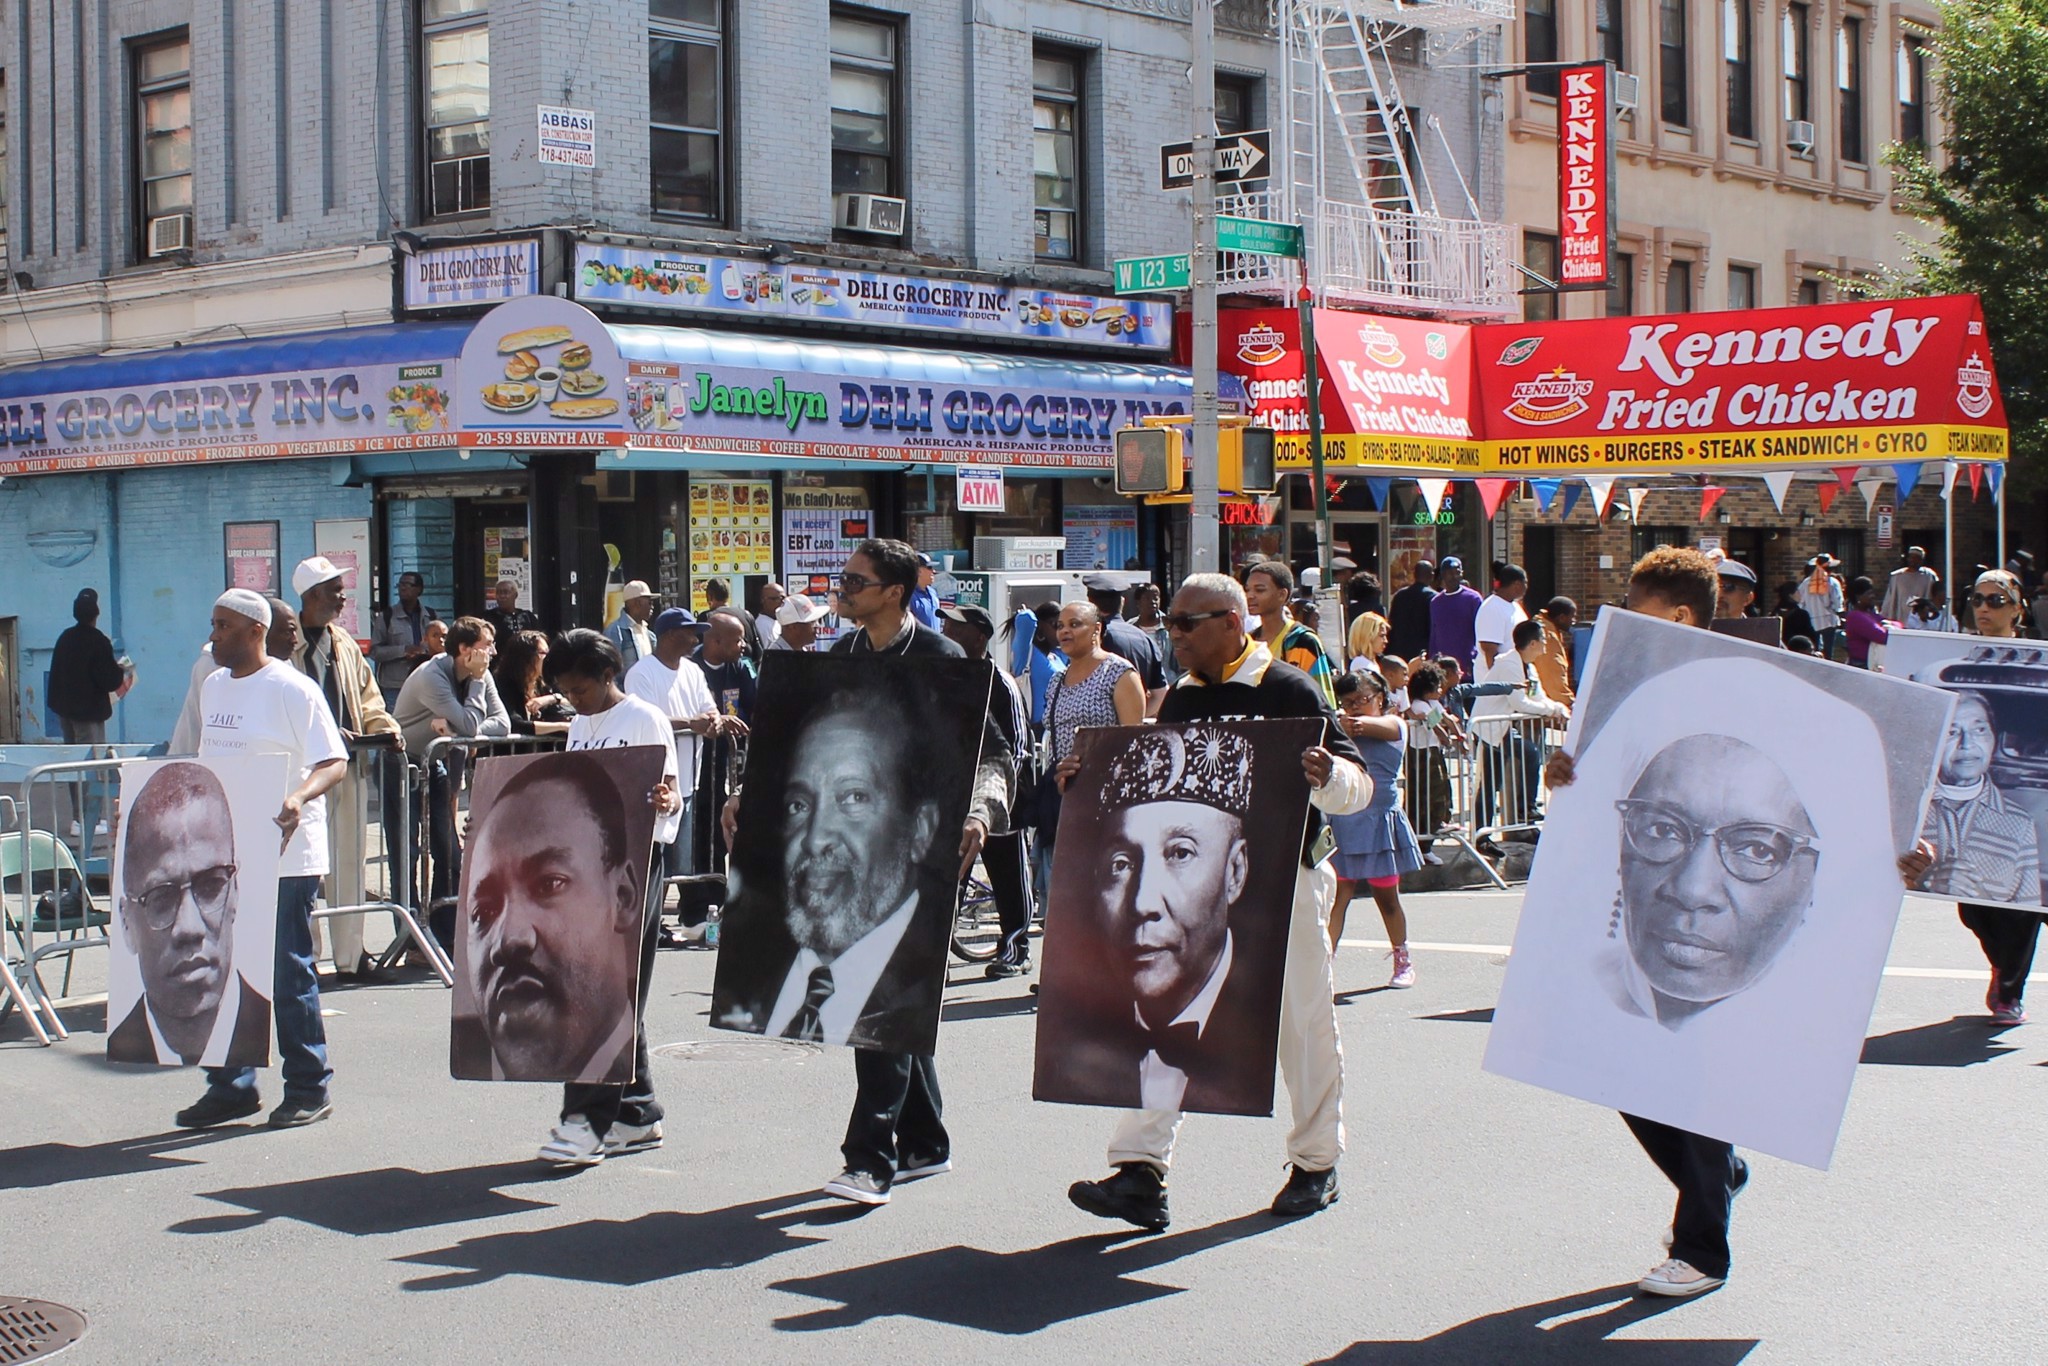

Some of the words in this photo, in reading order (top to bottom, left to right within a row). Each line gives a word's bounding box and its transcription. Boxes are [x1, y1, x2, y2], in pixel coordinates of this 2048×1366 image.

[541, 113, 593, 131] ABBASI
[1177, 157, 1193, 174] ON
[1221, 148, 1253, 169] WAY
[1566, 72, 1597, 234] KENNEDY
[1219, 220, 1236, 235] ADAM
[1237, 222, 1263, 239] CLAYTON
[1264, 225, 1285, 240] POWELL
[1240, 239, 1275, 251] BOULEVARD
[1565, 235, 1599, 257] Fried
[420, 262, 446, 283] DELI
[449, 256, 500, 280] GROCERY
[503, 254, 527, 275] INC.
[660, 261, 700, 272] PRODUCE
[1119, 264, 1132, 289] W
[1139, 260, 1166, 287] 123
[1173, 258, 1186, 273] ST
[1562, 259, 1602, 279] Chicken
[428, 283, 457, 293] AMERICAN
[463, 280, 490, 290] HISPANIC
[490, 277, 520, 288] PRODUCTS
[803, 276, 828, 284] DAIRY
[847, 279, 888, 300] DELI
[893, 284, 974, 310] GROCERY
[978, 292, 1011, 312] INC.
[859, 301, 906, 313] AMERICAN
[907, 305, 915, 314] &
[916, 306, 956, 317] HISPANIC
[958, 310, 1001, 321] PRODUCTS
[1239, 335, 1283, 345] KENNEDY'S
[1617, 307, 1940, 386] Kennedy
[403, 366, 437, 378] PRODUCE
[640, 365, 667, 375] DAIRY
[1338, 360, 1450, 406] Kennedy
[1513, 382, 1590, 396] KENNEDY'S
[0, 402, 47, 446] LI
[56, 381, 262, 441] GROCERY
[271, 374, 375, 426] INC.
[690, 373, 828, 433] Janelyn
[839, 382, 933, 432] DELI
[942, 390, 1117, 440] GROCERY
[1597, 386, 1721, 430] Fried
[1727, 379, 1918, 426] Chicken
[1352, 403, 1405, 432] Fried
[1405, 405, 1473, 437] Chicken
[20, 446, 89, 458] AMERICAN
[93, 444, 106, 453] &
[108, 439, 175, 451] HISPANIC
[179, 433, 258, 447] PRODUCTS
[476, 432, 513, 445] 20-59
[515, 432, 577, 445] SEVENTH
[579, 432, 609, 445] AVE.
[903, 437, 972, 449] AMERICAN
[975, 439, 985, 449] &
[989, 441, 1047, 452] HISPANIC
[1050, 443, 1113, 454] PRODUCTS
[1499, 446, 1531, 465] HOT
[1536, 444, 1590, 464] WINGS
[1604, 441, 1684, 462] BURGERS
[1699, 438, 1756, 460] STEAK
[1762, 434, 1858, 457] SANDWICH
[1876, 432, 1927, 453] GYRO
[1948, 432, 1970, 452] STEAK
[1971, 433, 2004, 453] SANDWICH
[0, 462, 19, 473] ODA
[26, 460, 49, 472] MILK
[56, 457, 88, 470] JUICES
[95, 455, 136, 468] CANDIES
[144, 452, 170, 463] COLD
[172, 450, 197, 461] CUTS
[205, 446, 246, 458] FROZEN
[248, 444, 278, 456] FOOD
[287, 440, 356, 455] VEGETABLES
[365, 438, 384, 450] ICE
[393, 436, 412, 449] ICE
[416, 434, 458, 448] CREAM
[629, 434, 652, 447] HOT
[654, 435, 663, 447] &
[665, 436, 693, 449] COLD
[694, 437, 761, 452] SANDWICHES
[769, 440, 805, 453] COFFEE
[813, 443, 870, 458] CHOCOLATE
[877, 446, 901, 459] SODA
[909, 448, 931, 460] MILK
[938, 449, 969, 462] JUICES
[976, 451, 1013, 463] CANDIES
[1020, 452, 1042, 464] COLD
[1043, 453, 1065, 465] CUTS
[1071, 454, 1103, 467] FROZEN
[1104, 456, 1115, 467] FO
[1276, 441, 1298, 461] OOD
[1305, 441, 1345, 461] SADS
[1362, 442, 1384, 460] GYROS
[1389, 443, 1403, 461] SEA
[1404, 444, 1421, 462] FOOD
[1426, 446, 1450, 464] SALADS
[1456, 447, 1480, 466] DRINKS
[785, 493, 802, 506] We
[804, 492, 834, 508] Gladly
[962, 481, 1000, 505] ATM
[804, 520, 831, 529] ACCEPT
[1414, 511, 1455, 525] SEAOOD
[788, 535, 812, 550] EBT
[814, 540, 834, 550] CARD
[1017, 539, 1051, 548] packaged
[1009, 559, 1027, 568] clear
[1029, 553, 1053, 569] ICE
[957, 578, 983, 595] port
